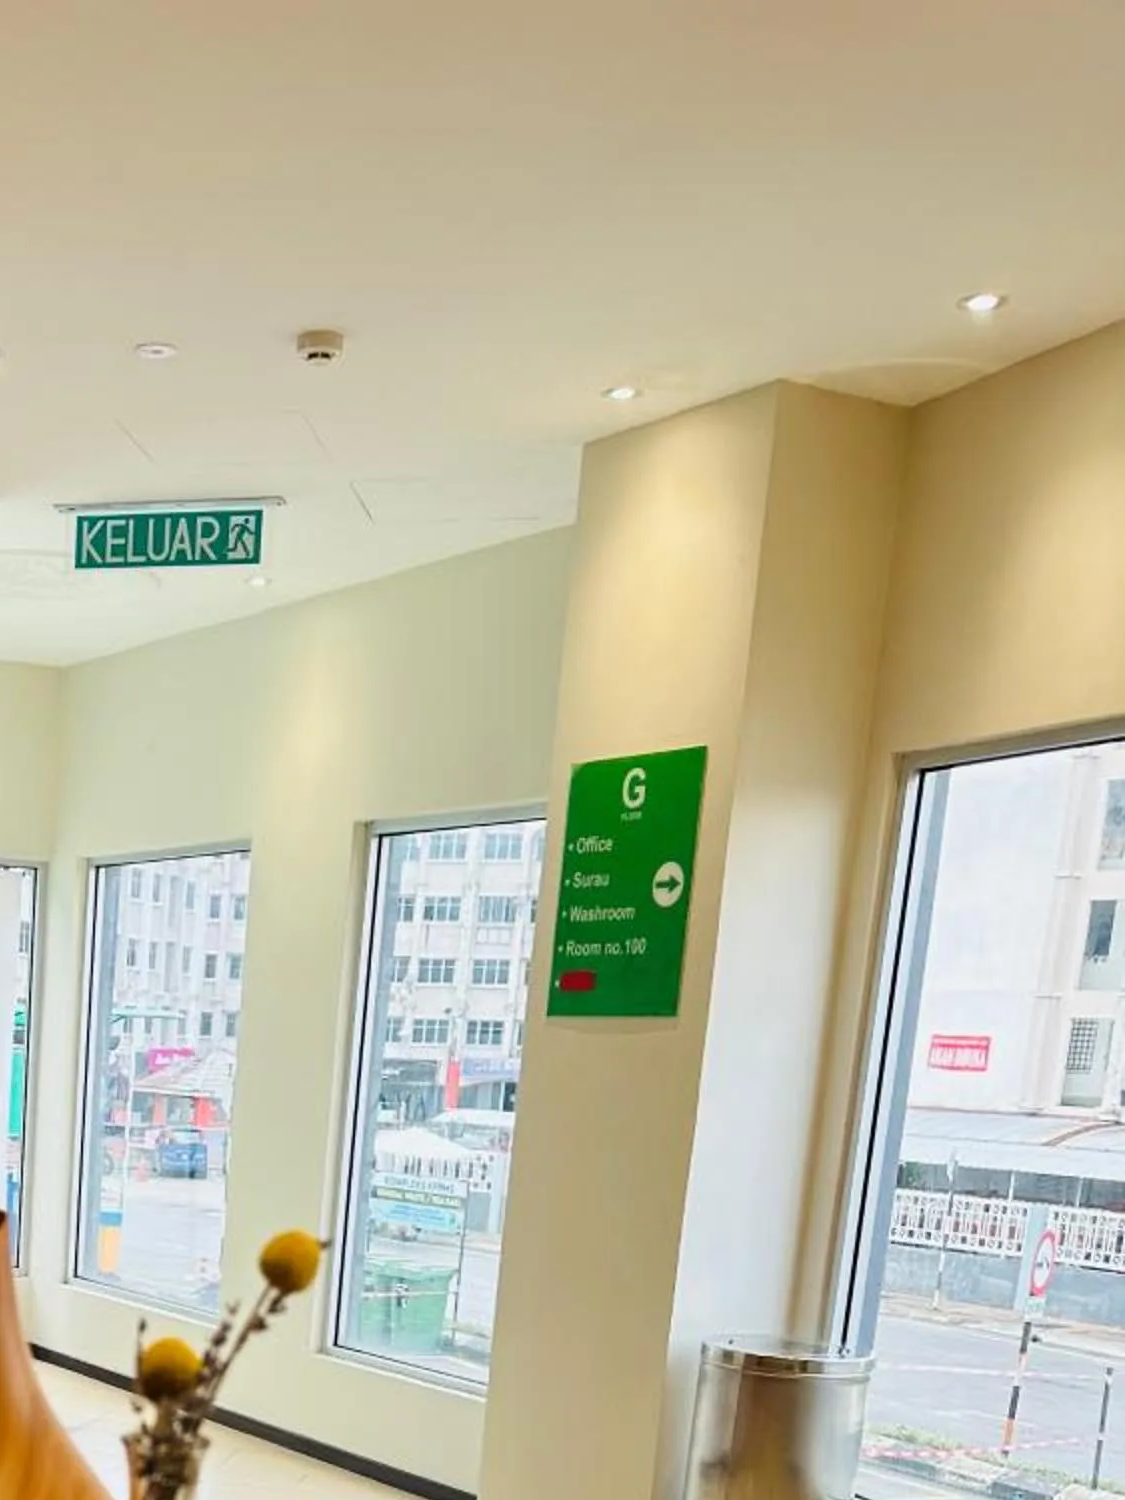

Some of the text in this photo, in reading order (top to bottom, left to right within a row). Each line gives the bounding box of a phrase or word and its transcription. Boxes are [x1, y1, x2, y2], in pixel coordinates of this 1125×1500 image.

[80, 515, 221, 564] KELUAR
[622, 767, 646, 809] G
[576, 835, 614, 855] Office
[572, 871, 611, 889] Surau
[569, 904, 636, 923] Washroom
[565, 939, 603, 958] Room
